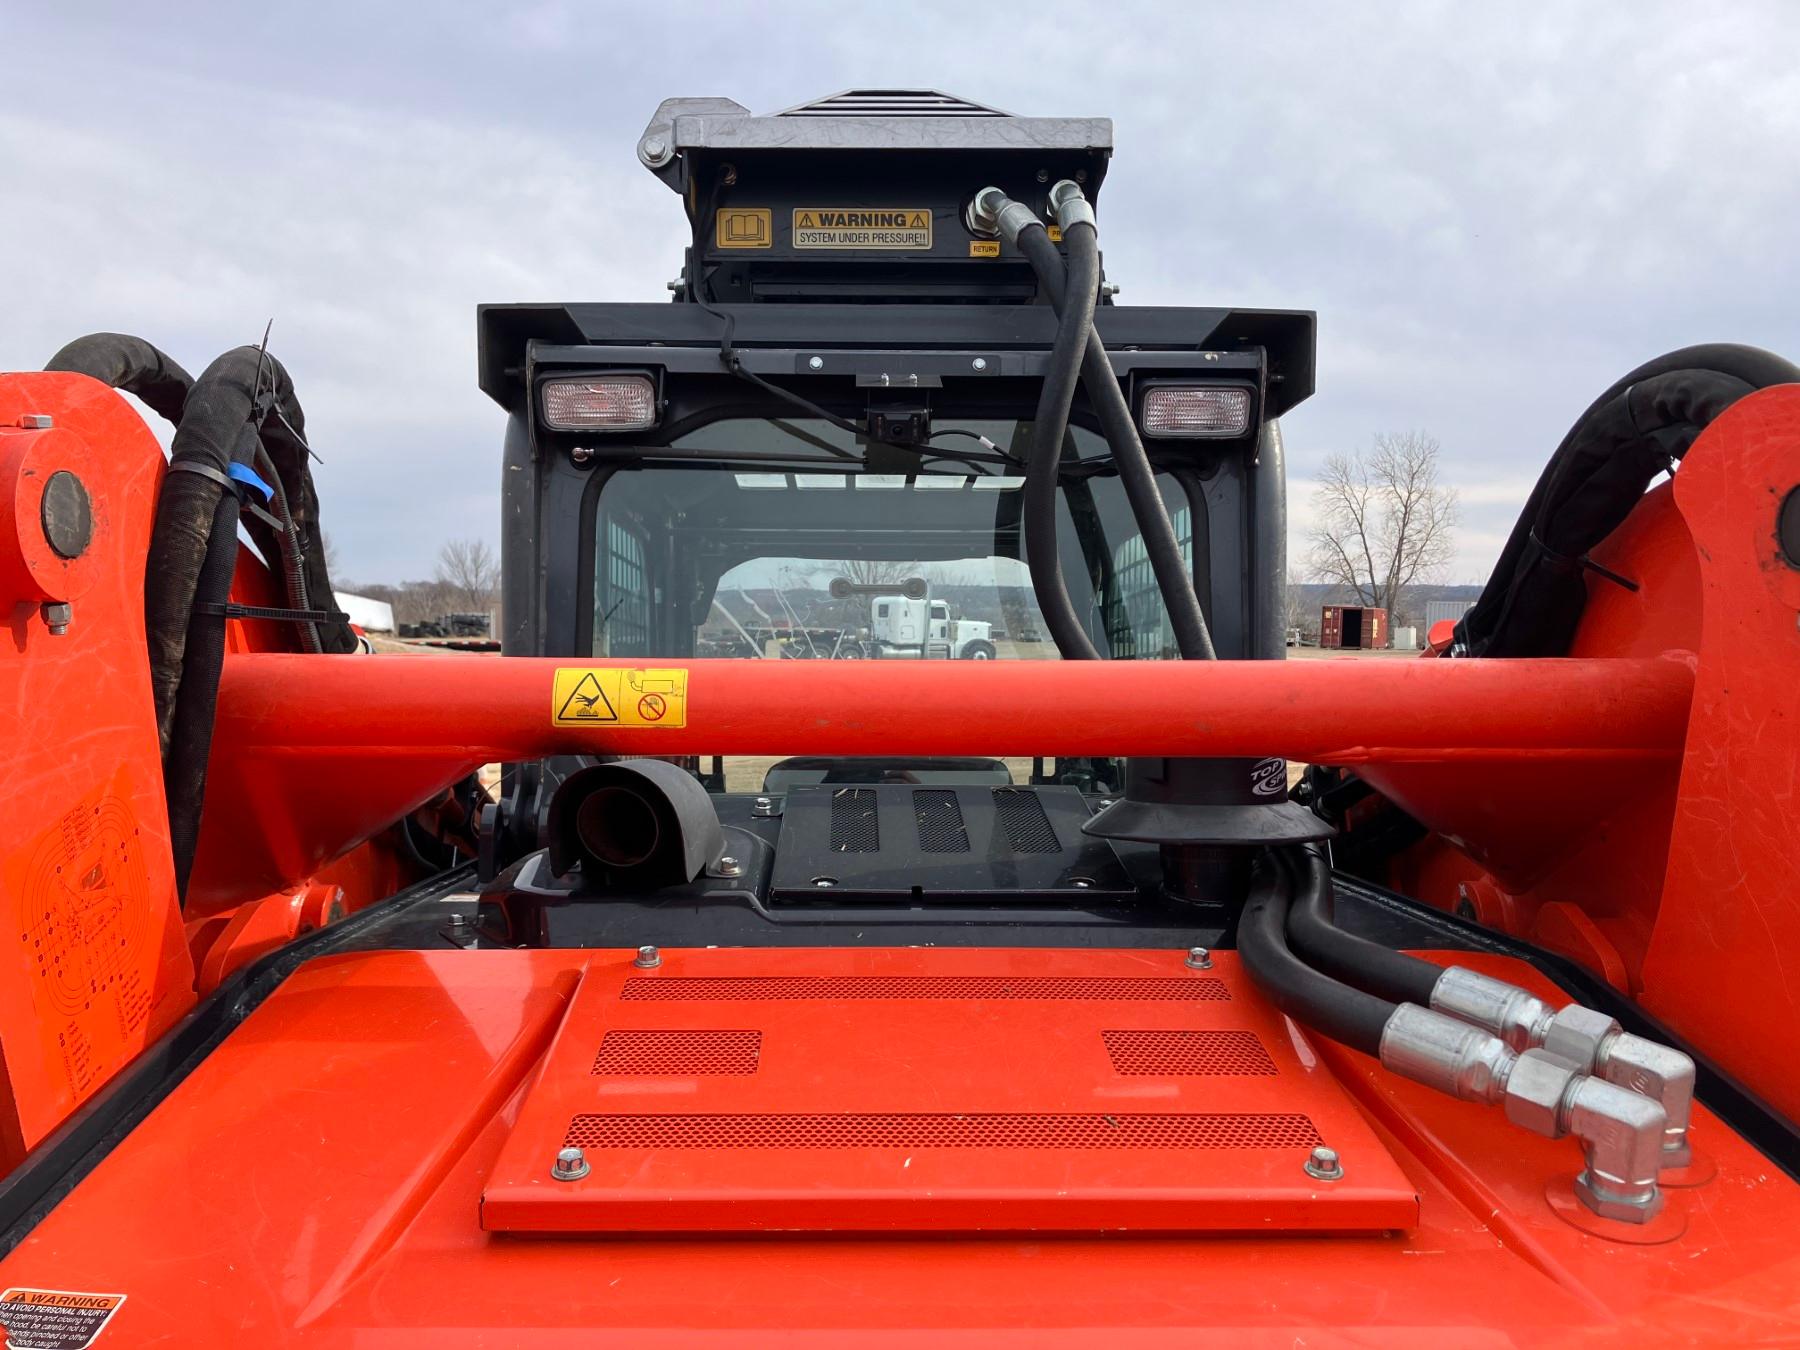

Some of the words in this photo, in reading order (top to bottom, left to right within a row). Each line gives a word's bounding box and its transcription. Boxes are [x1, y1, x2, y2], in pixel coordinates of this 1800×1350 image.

[818, 213, 907, 227] WARNING
[800, 232, 837, 243] SYSTEM
[838, 232, 869, 243] UNDER
[872, 232, 926, 243] PRESSURE!!
[973, 245, 997, 253] RETURN
[1250, 761, 1279, 780] TOP
[31, 1294, 110, 1307] WARNING
[9, 1303, 35, 1312] AVOID
[34, 1305, 75, 1315] PERSONAL
[13, 1313, 42, 1322] opening
[57, 1316, 83, 1326] closing
[83, 1317, 95, 1325] the
[30, 1322, 41, 1330] be
[29, 1331, 60, 1339] pinched
[15, 1339, 34, 1347] body
[35, 1340, 61, 1349] caught
